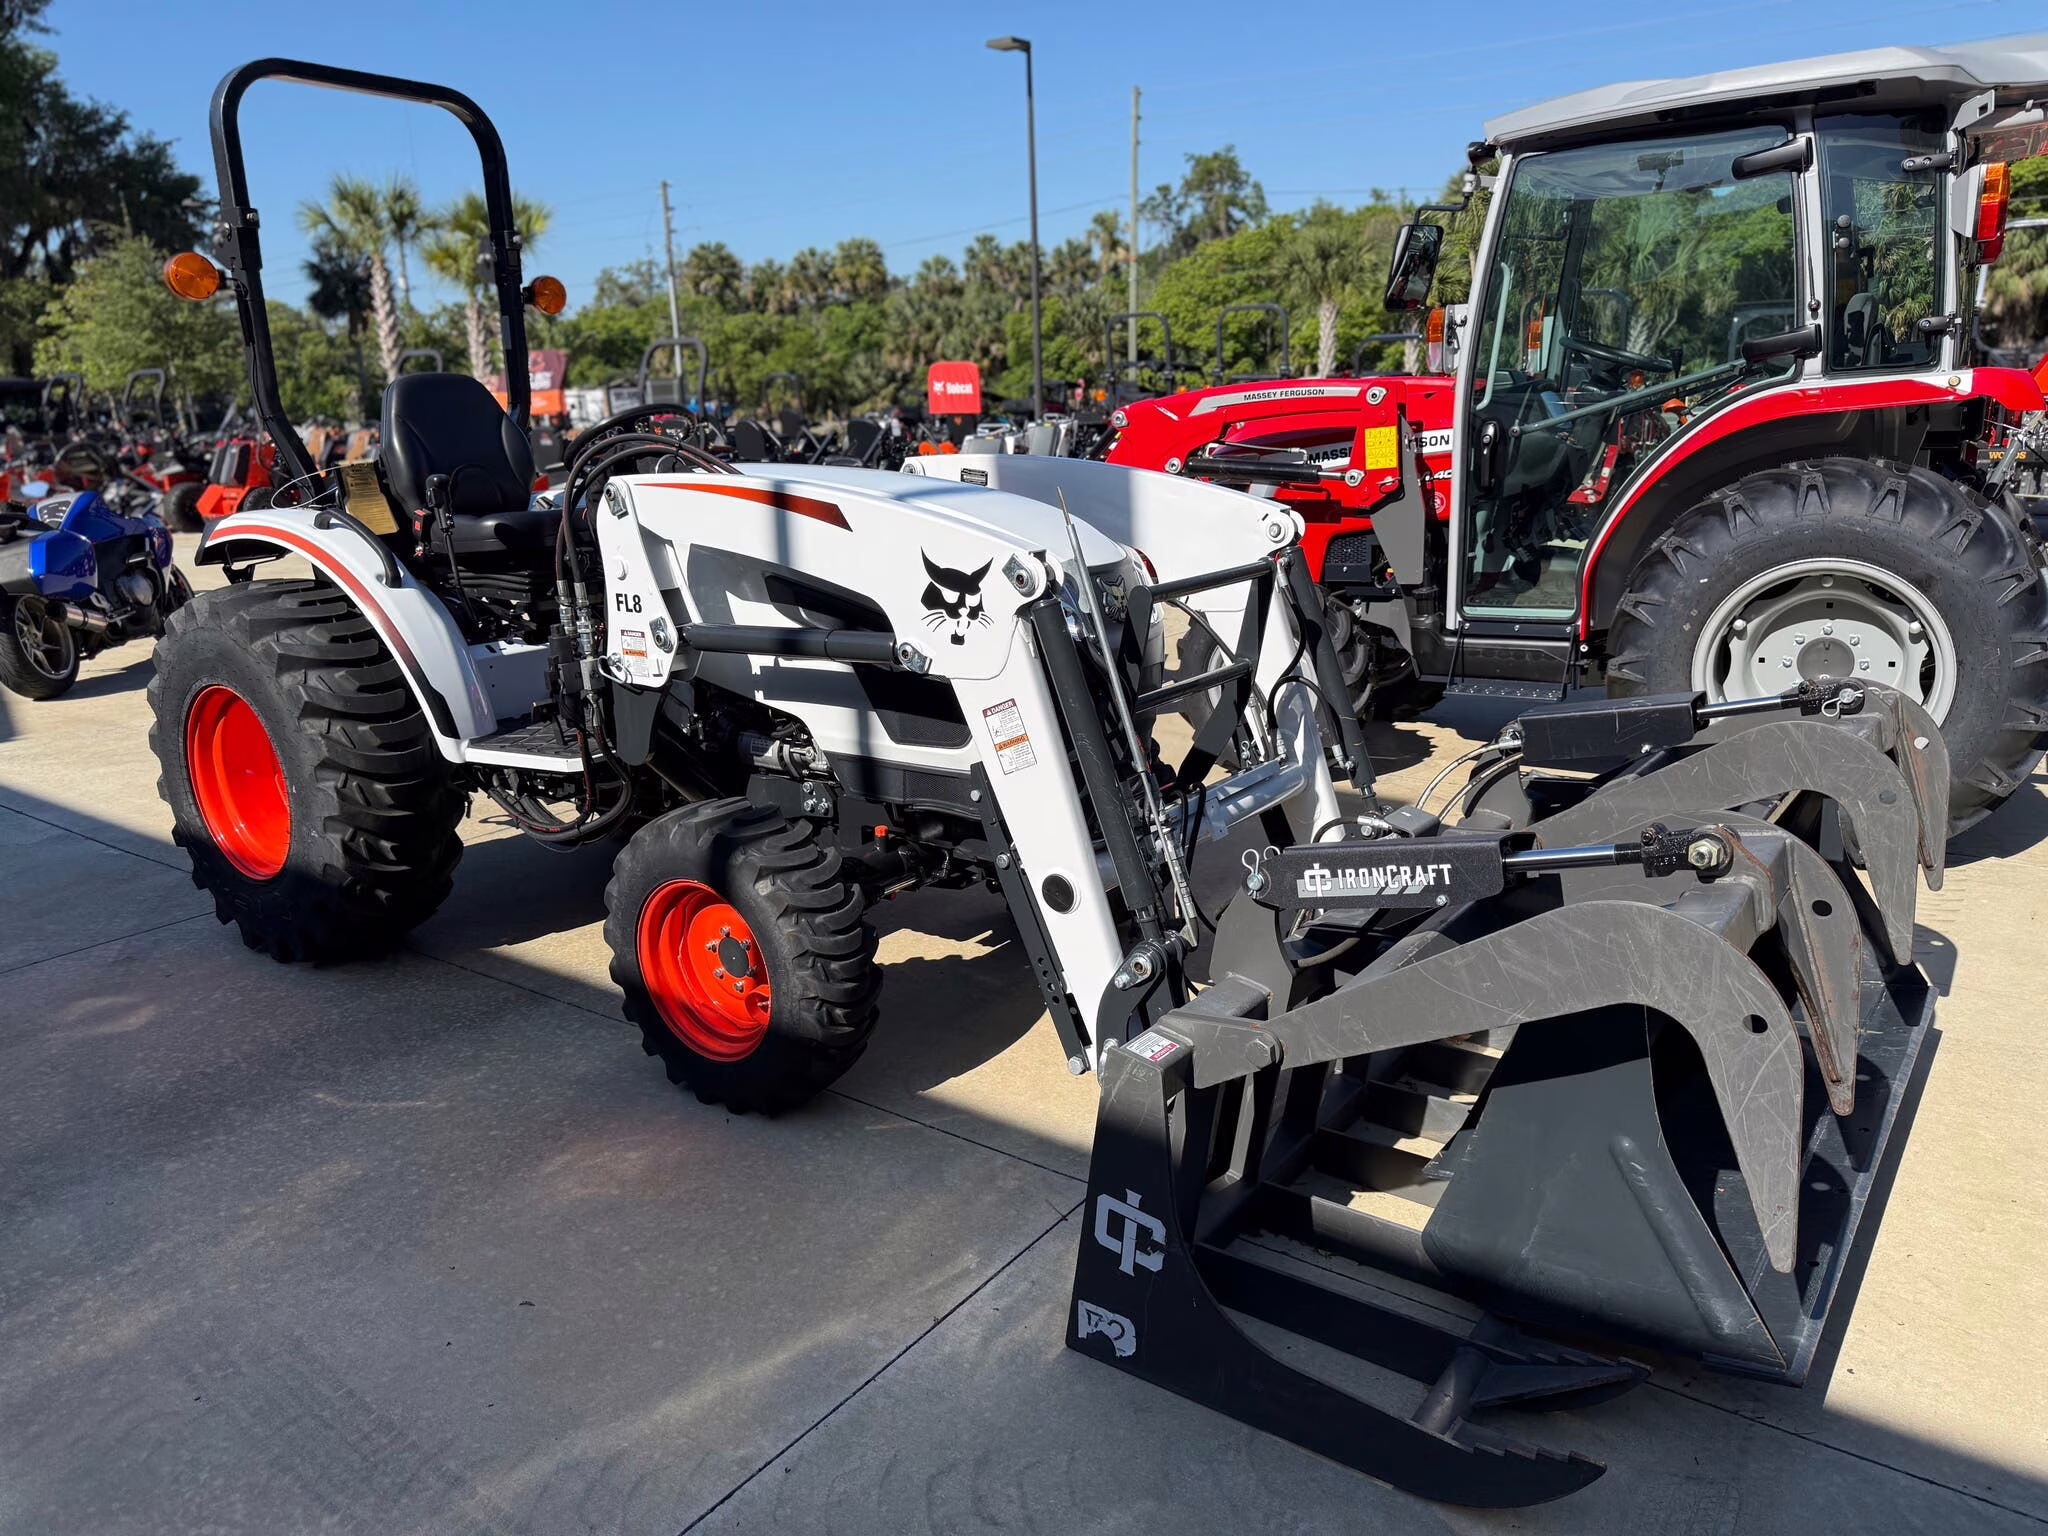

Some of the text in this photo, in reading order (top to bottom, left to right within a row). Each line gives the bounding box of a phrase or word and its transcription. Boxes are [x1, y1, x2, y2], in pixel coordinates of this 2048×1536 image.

[1244, 388, 1325, 401] MASSEY FERGUSON
[1989, 451, 2026, 460] WOS
[616, 593, 642, 613] FL8
[991, 701, 1014, 713] DANGER
[1337, 863, 1452, 889] IRONCRAFT
